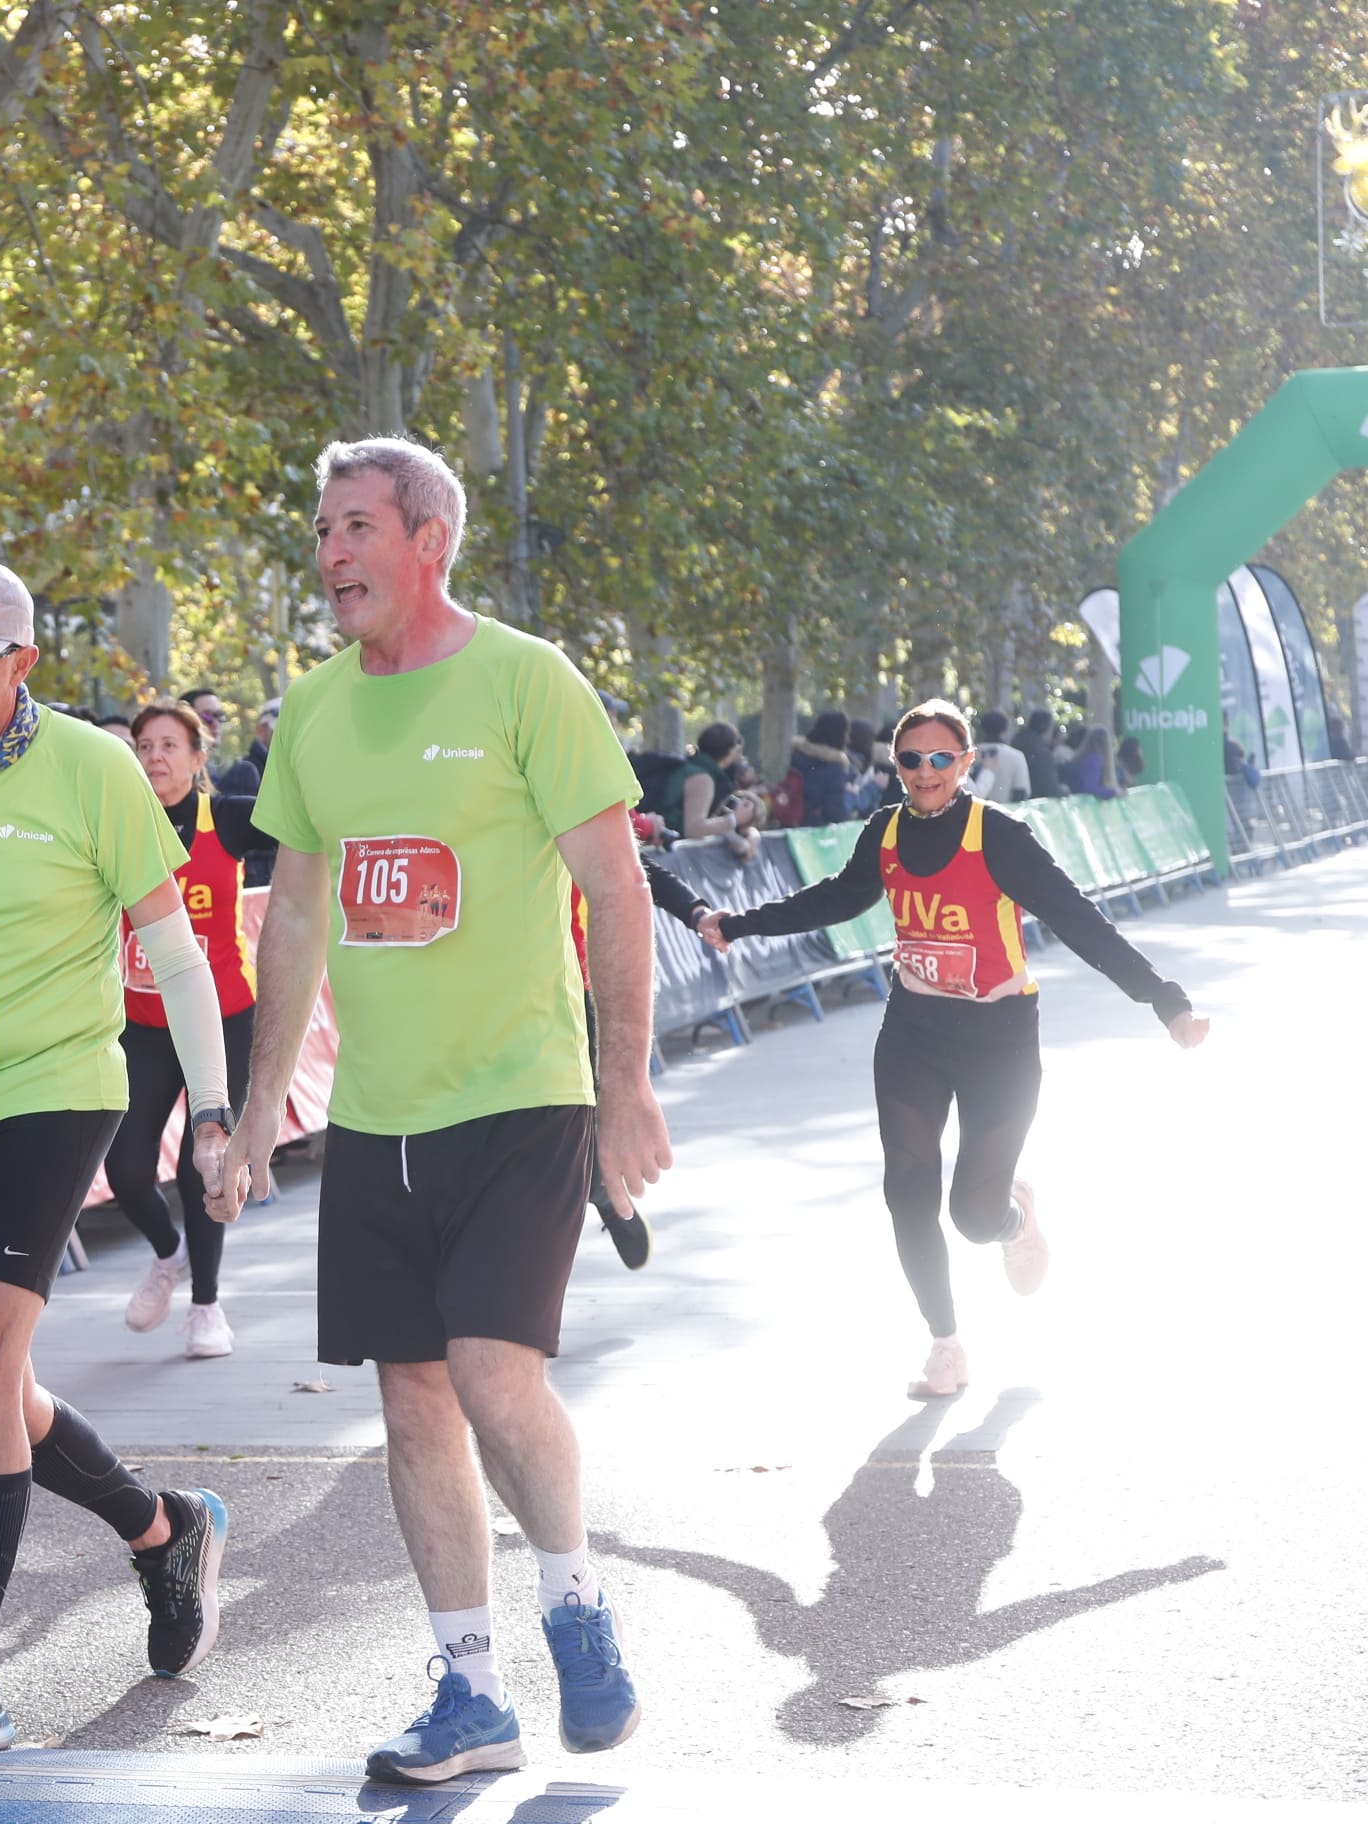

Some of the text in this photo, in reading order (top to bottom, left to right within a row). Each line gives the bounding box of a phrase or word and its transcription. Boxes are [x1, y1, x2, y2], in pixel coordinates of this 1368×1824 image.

[1125, 704, 1208, 736] Unicaja
[442, 746, 485, 760] Unicaja
[16, 829, 54, 844] Unicaja
[356, 858, 409, 905] 105
